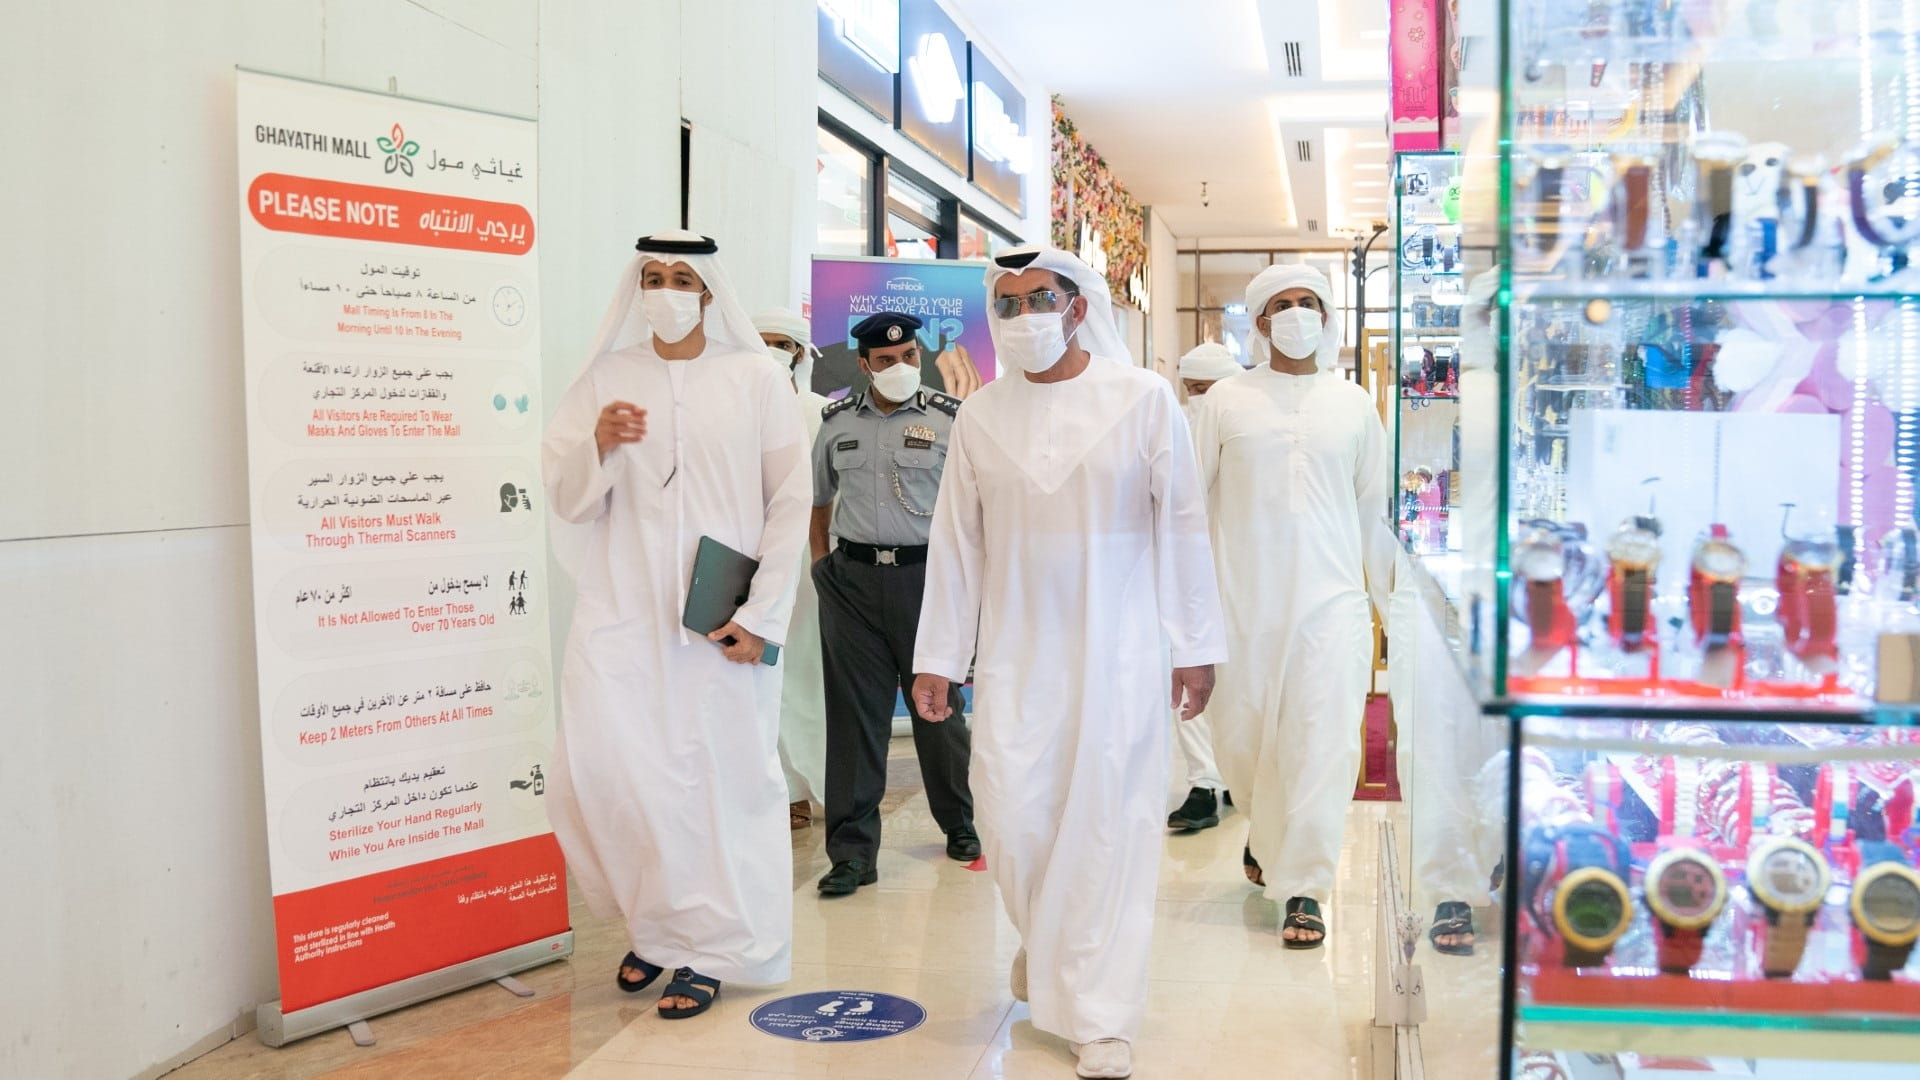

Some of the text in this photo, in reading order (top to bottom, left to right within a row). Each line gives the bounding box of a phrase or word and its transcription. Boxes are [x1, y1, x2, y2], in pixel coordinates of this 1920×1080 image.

[256, 124, 371, 159] GHAYATHI MALL
[426, 149, 523, 183] غياثي مول
[259, 190, 400, 228] PLEASE NOTE
[419, 209, 474, 237] الانتباه
[360, 263, 421, 280] توقيت المول
[886, 280, 924, 292] Freshlook
[427, 288, 460, 302] الساعة
[462, 295, 476, 304] من
[850, 295, 963, 307] WHY SHOULD YOUR
[343, 303, 453, 321] Mall Timing Is From In The
[850, 304, 963, 317] NAILS HAVE ALL THE
[337, 322, 462, 342] Morning Until 10 In The Evening
[334, 364, 360, 378] ارتداء
[364, 365, 388, 378] الزوار
[392, 368, 413, 381] جميع
[435, 370, 454, 381] يجب
[312, 386, 447, 400] والقفازات لدخول المركز التجاري
[312, 409, 452, 424] All Visitors Are Required To Wear
[307, 424, 461, 438] Masks And Gloves To Enter The Mall
[307, 472, 333, 487] السير
[338, 472, 367, 486] الزوار
[371, 475, 396, 487] جميع
[423, 474, 444, 484] يجب
[296, 492, 452, 510] عبر الماسحات الضوئية الحرارية
[320, 512, 441, 530] All Visitors Must Walk
[306, 528, 456, 549] Through Thermal Scanners
[428, 574, 489, 596] لا يسمح بدخول من
[295, 588, 309, 608] عام
[324, 588, 336, 604] من
[318, 602, 474, 628] It Is Not Allowed To Enter Those
[412, 612, 495, 634] Over 70 Years Old
[436, 684, 457, 698] مسافة
[474, 679, 492, 692] حافظ
[354, 696, 365, 714] في
[398, 694, 409, 706] عن
[413, 690, 425, 704] متر
[332, 702, 352, 718] جميع
[299, 704, 494, 746] Keep 2 Meters From Others At All Times
[363, 766, 446, 792] تعقيم يديك بانتظام
[328, 780, 479, 822] عندما تكون داخل المركز التجاري
[329, 800, 483, 842] Sterilize Your Hand Regularly
[329, 818, 485, 862] While You Are Inside The Mall
[293, 912, 390, 944] This store is regularly cleaned
[294, 920, 396, 954] and sterilized in line with Health
[294, 938, 363, 963] Authority instructions
